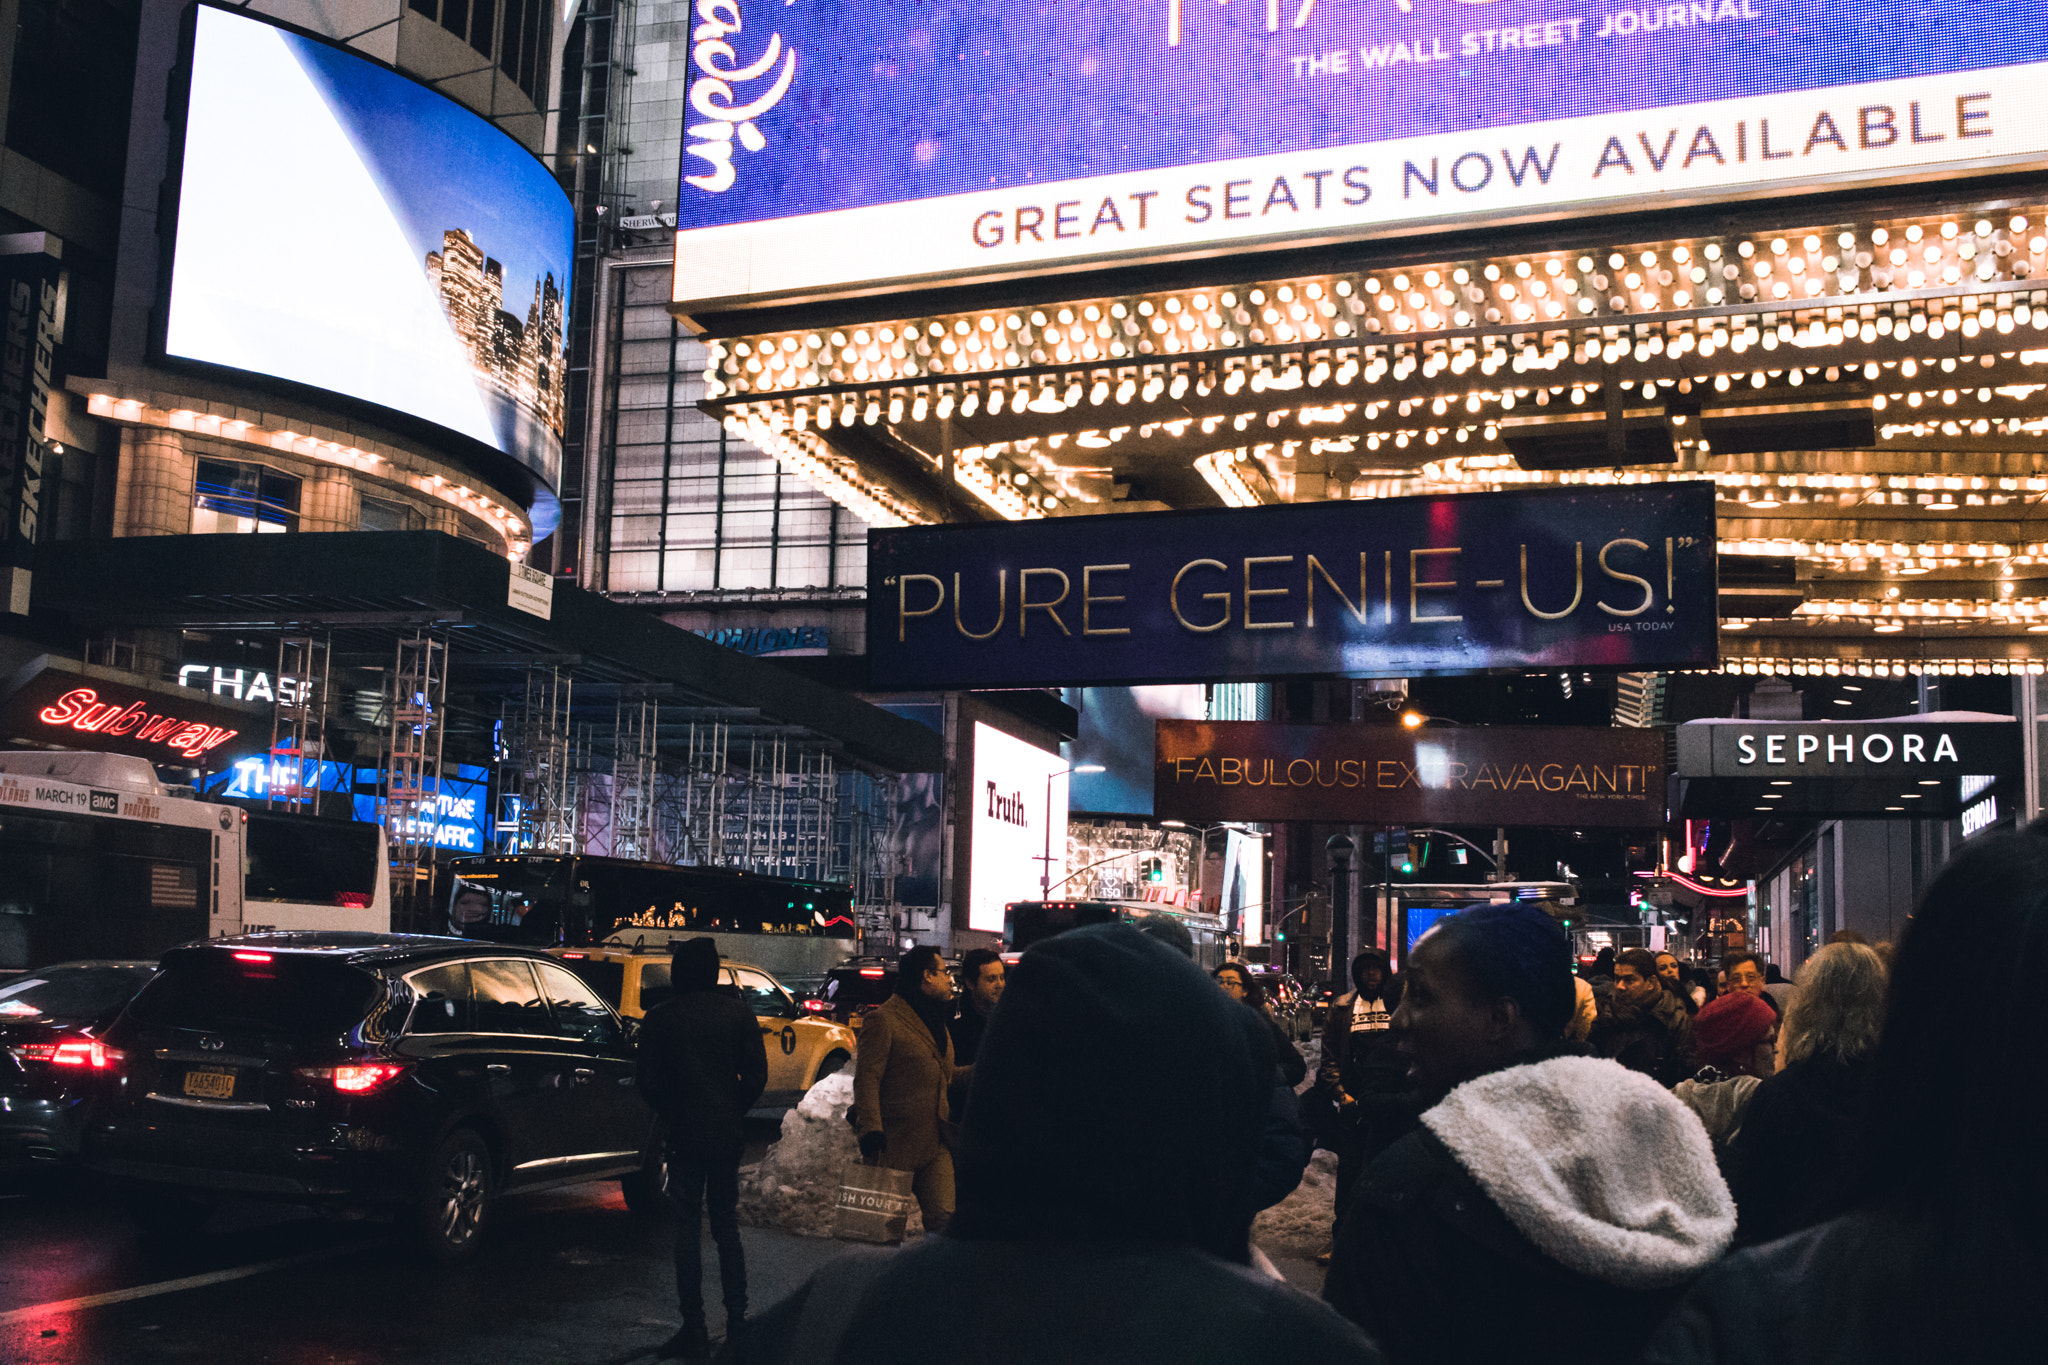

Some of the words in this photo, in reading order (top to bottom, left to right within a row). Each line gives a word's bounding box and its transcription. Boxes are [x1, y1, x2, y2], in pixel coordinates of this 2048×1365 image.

[1290, 53, 1348, 79] THE
[1361, 37, 1450, 68] WALL
[1461, 18, 1585, 56] STREET
[1597, 0, 1762, 38] JOURNAL
[685, 0, 795, 192] addin
[972, 189, 1159, 249] GREAT
[1185, 165, 1372, 225] SEATS
[1402, 142, 1561, 200] NOW
[1593, 92, 1994, 180] AVAILABLE
[623, 217, 675, 228] SHERWO
[20, 278, 57, 545] SKECHERS
[884, 563, 1131, 642] “PURE
[1608, 623, 1632, 632] USA
[1636, 622, 1675, 632] TODAY
[39, 688, 238, 757] Subway
[1738, 733, 1959, 764] SEPHORA
[36, 787, 73, 805] MARCH
[76, 793, 87, 806] 19
[410, 795, 475, 820] APTURE
[986, 780, 1028, 828] Truth.
[861, 1196, 892, 1211] YOUR
